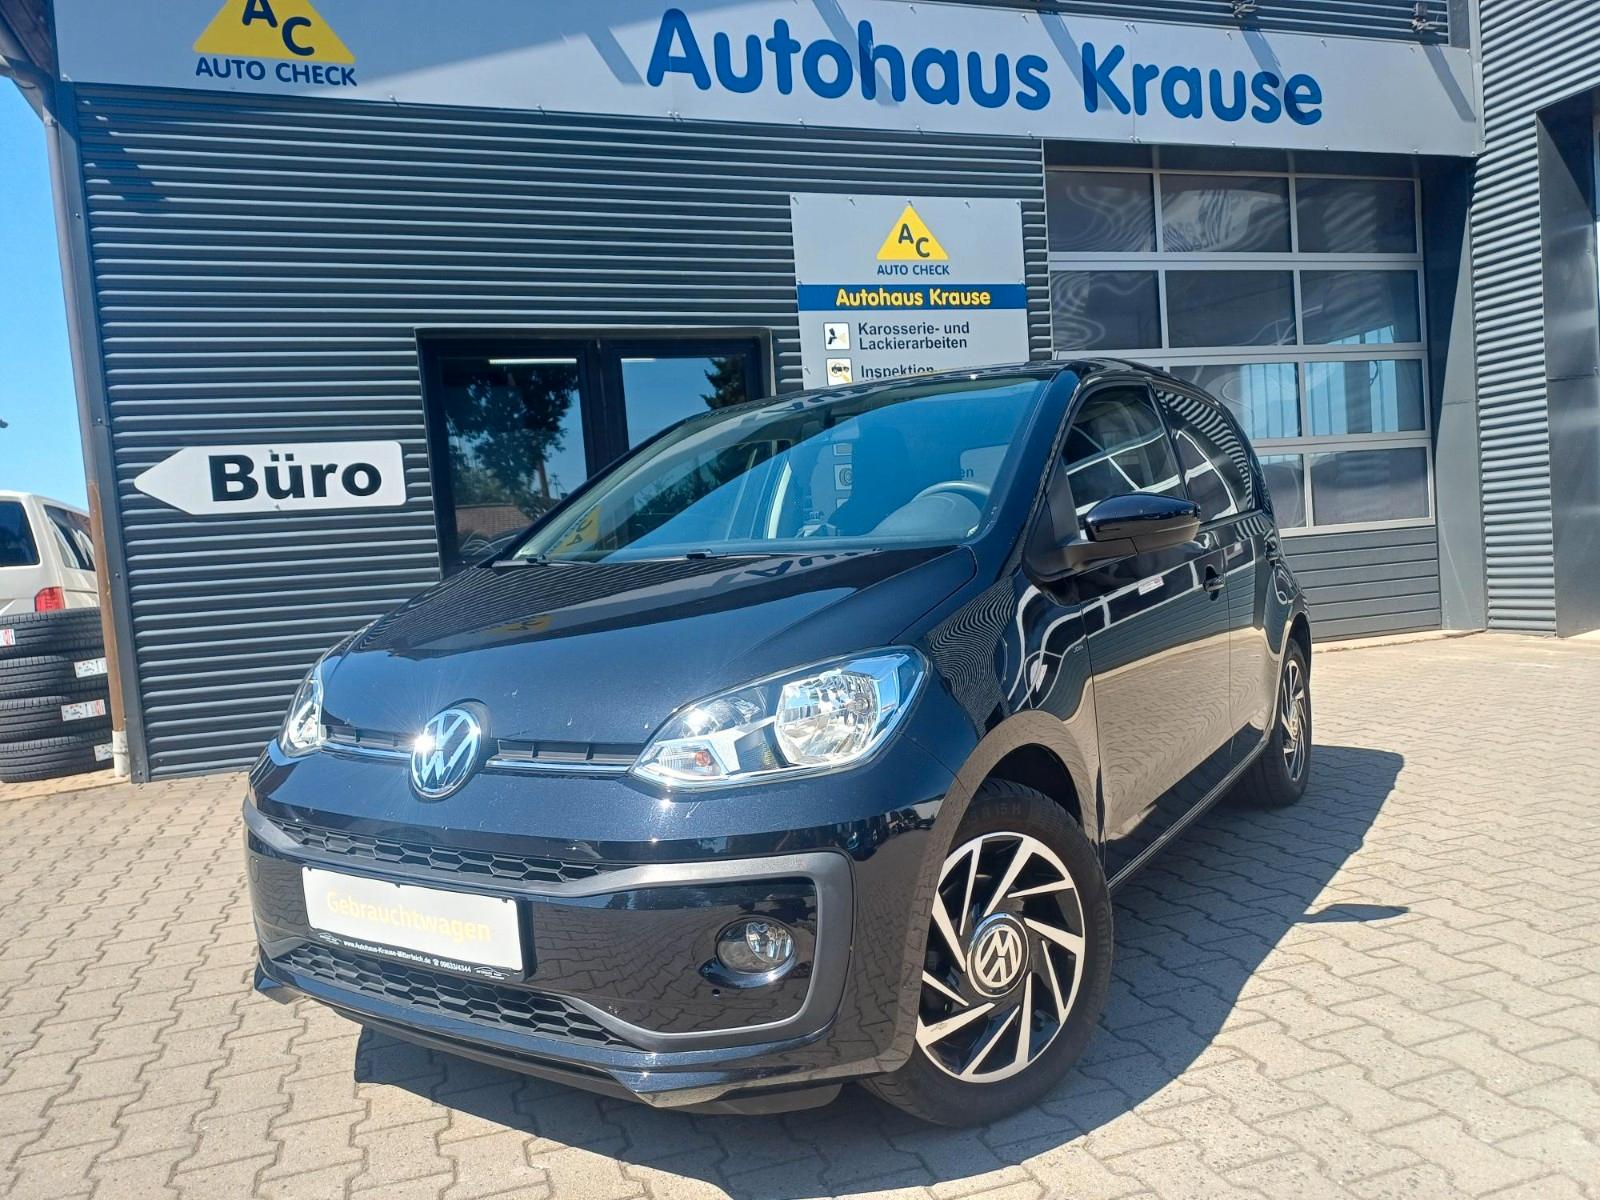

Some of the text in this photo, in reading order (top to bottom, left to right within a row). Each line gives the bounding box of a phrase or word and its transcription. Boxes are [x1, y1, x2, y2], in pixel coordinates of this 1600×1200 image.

[195, 57, 358, 87] AUTO CHECK
[646, 8, 1323, 125] Autohaus Krause
[876, 264, 950, 275] AUTO CHECK
[835, 288, 992, 307] Autohaus Krause
[858, 321, 970, 336] Karosserie- und
[858, 337, 968, 351] Lackierarbeiten
[207, 453, 382, 503] Büro
[326, 890, 493, 945] Gebrauchtwagen
